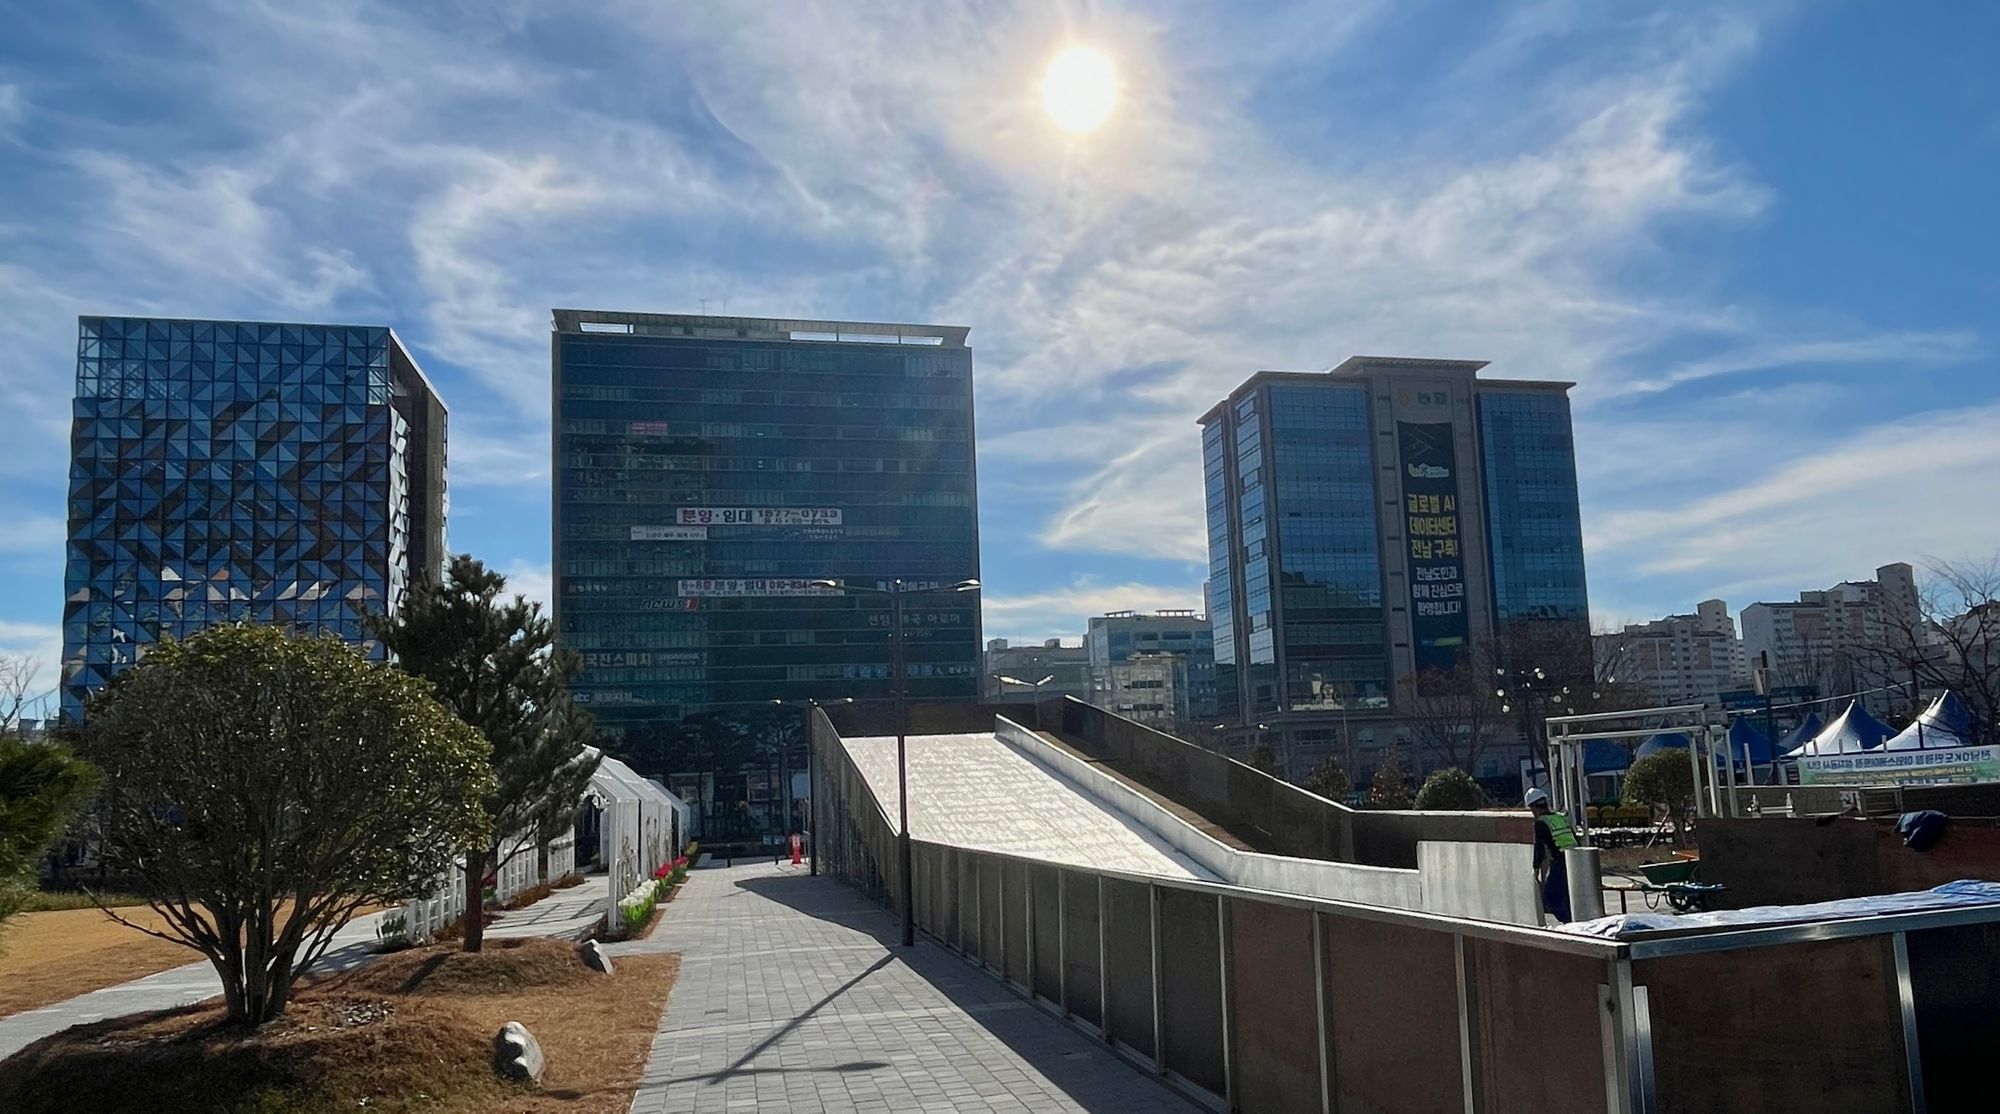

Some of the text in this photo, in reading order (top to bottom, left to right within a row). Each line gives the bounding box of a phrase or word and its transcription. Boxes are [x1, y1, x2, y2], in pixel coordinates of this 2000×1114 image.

[1408, 494, 1455, 513] 글로벌 AI
[1409, 516, 1457, 535] 데이터센터
[1411, 539, 1458, 559] 전남 구축!
[1416, 567, 1457, 581] 전남도민과
[1412, 583, 1464, 598] 함께 진심으로
[1417, 601, 1462, 616] 환영합니다!
[580, 652, 652, 667] 국진스피치
